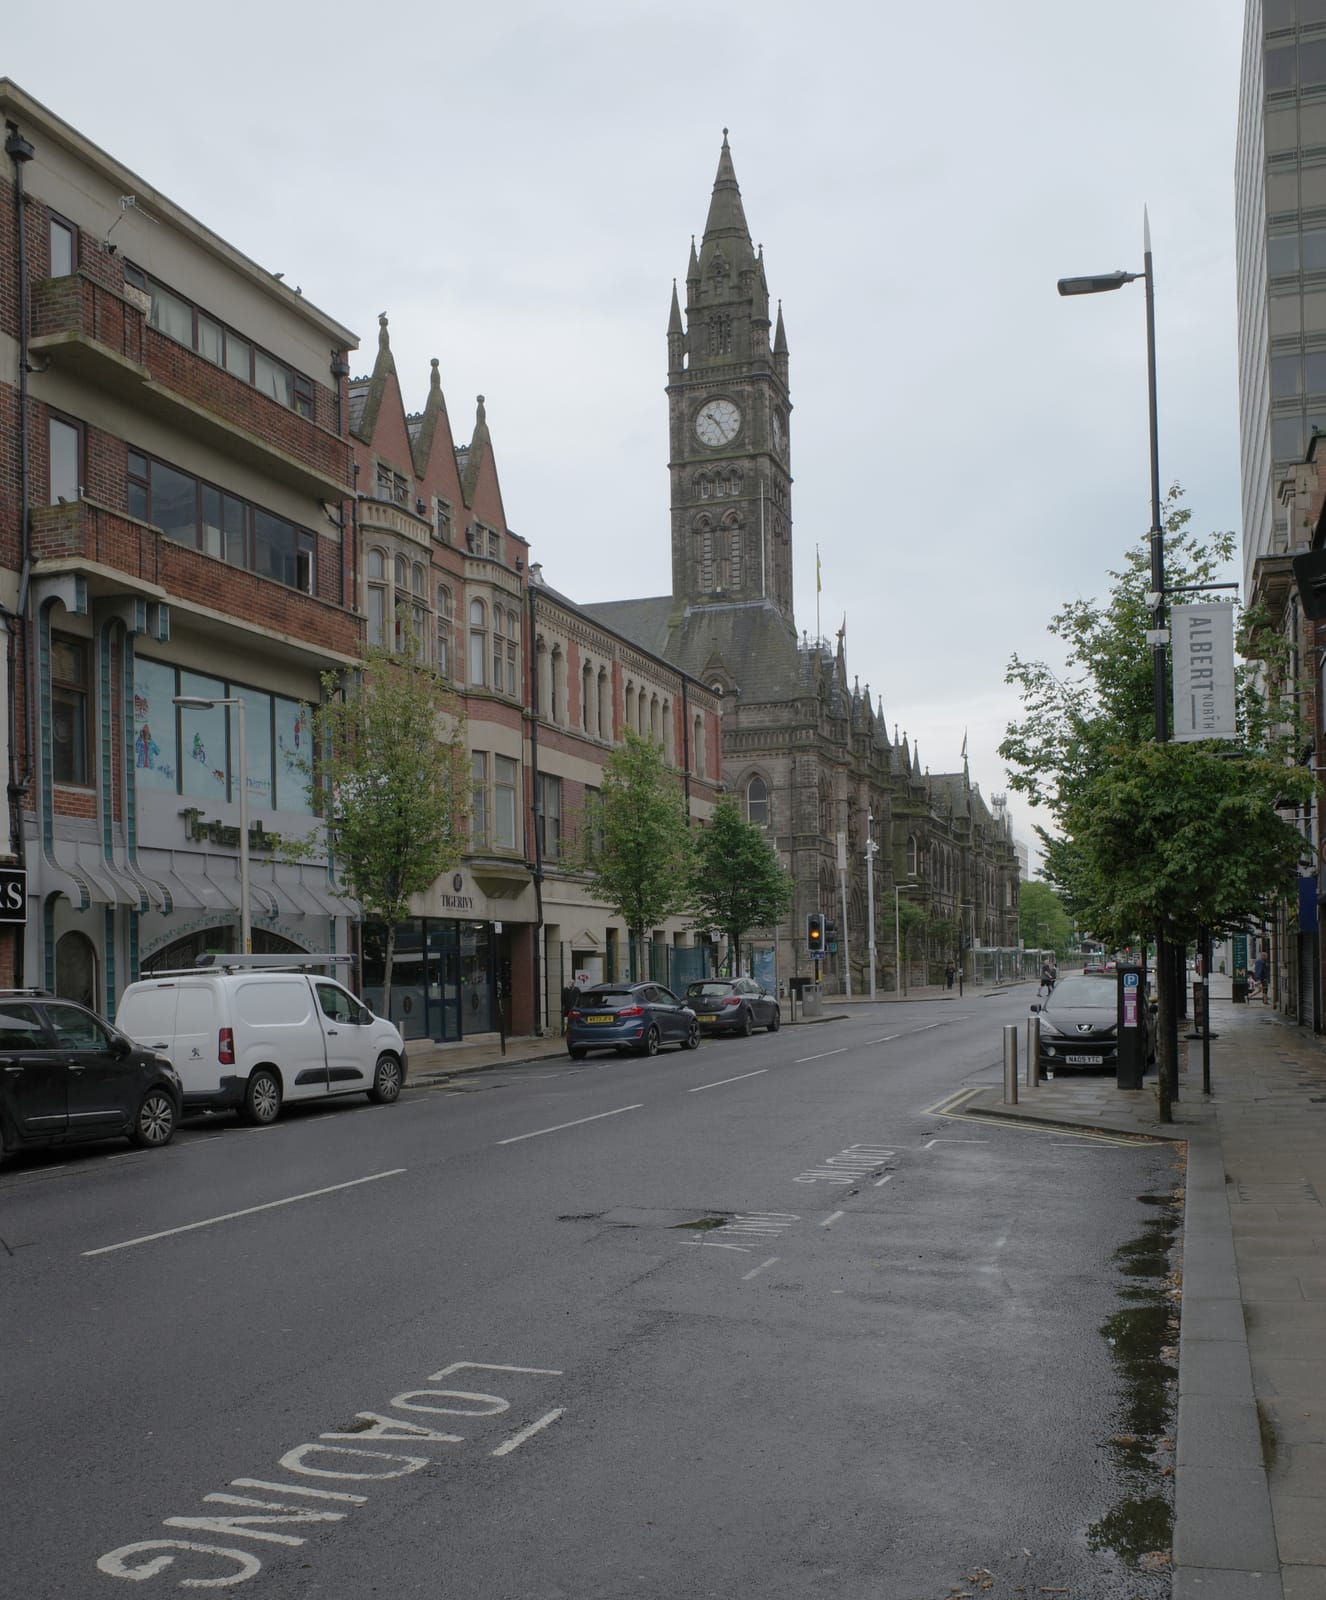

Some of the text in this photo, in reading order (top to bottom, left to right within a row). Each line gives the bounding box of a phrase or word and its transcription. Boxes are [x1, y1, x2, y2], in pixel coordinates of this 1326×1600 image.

[1189, 617, 1214, 691] ALBERT
[1202, 694, 1215, 729] NORTH
[0, 882, 22, 909] S
[1127, 975, 1136, 986] P
[792, 1143, 908, 1185] LOADING
[96, 1361, 563, 1588] LOADING
